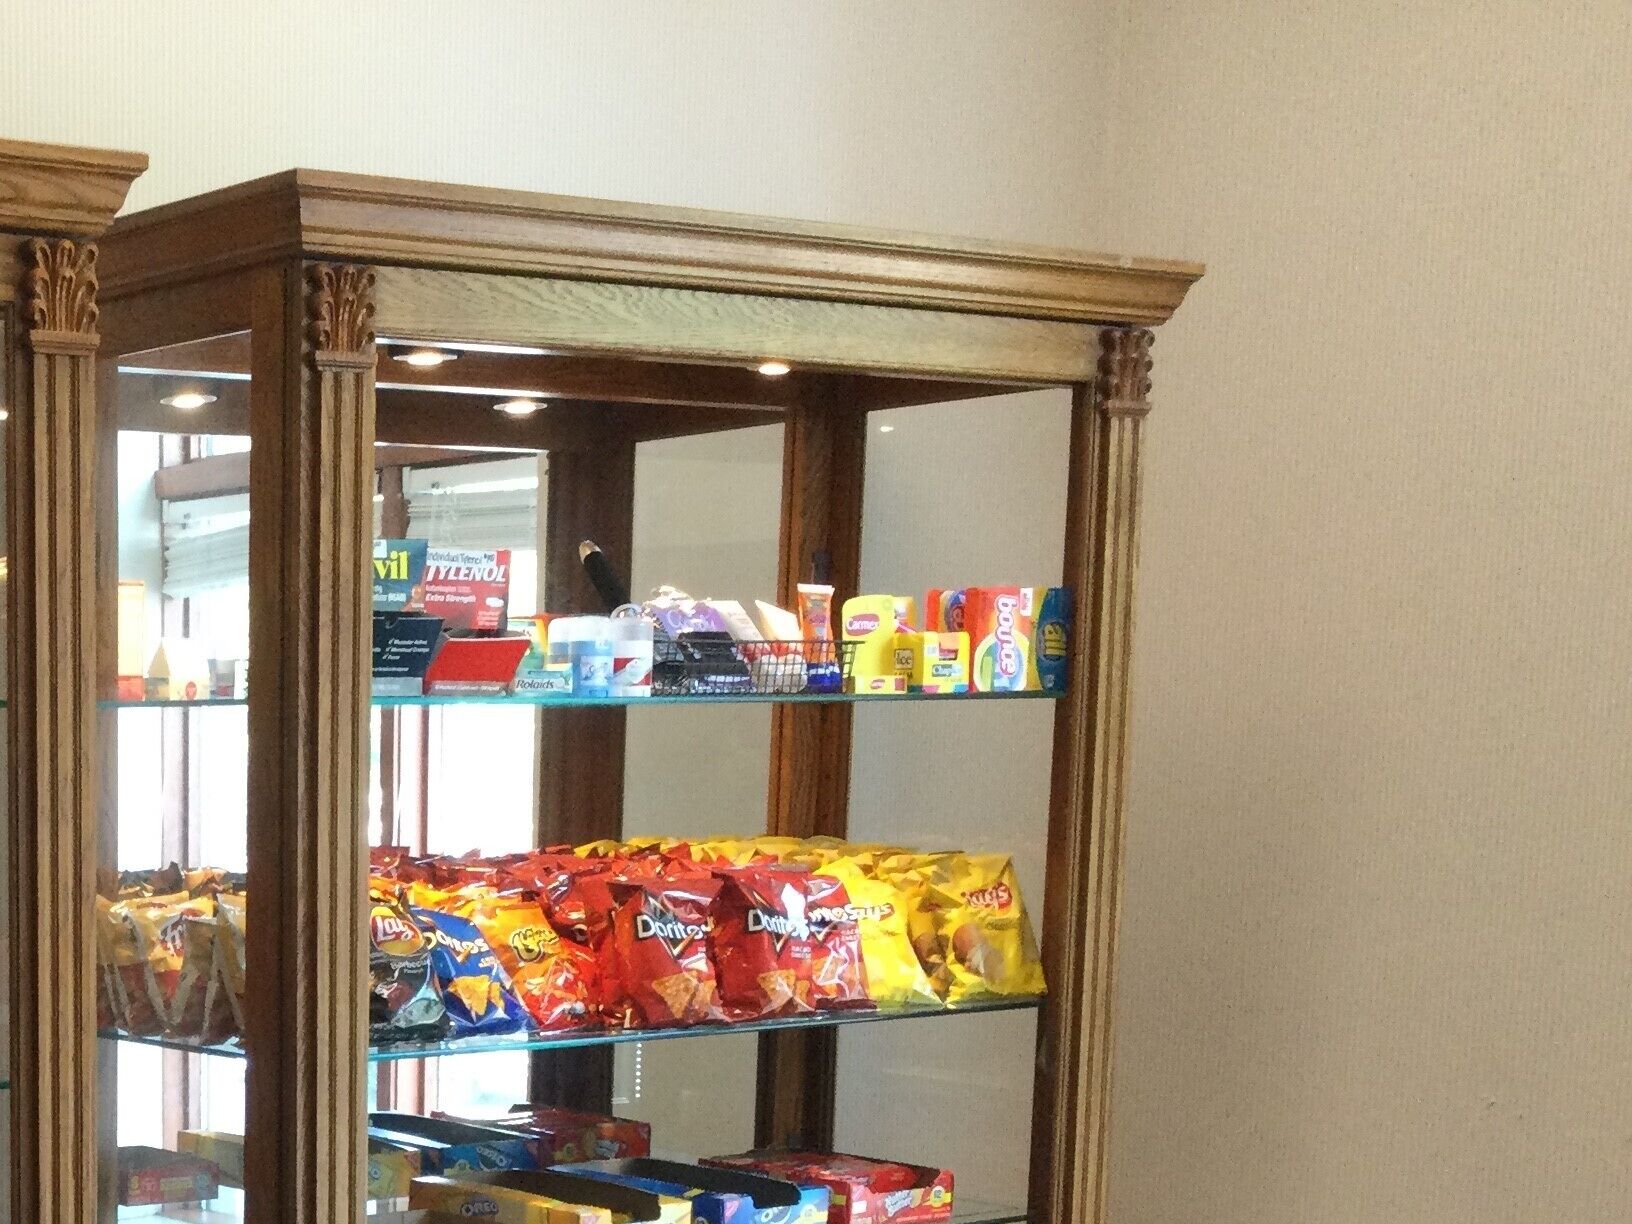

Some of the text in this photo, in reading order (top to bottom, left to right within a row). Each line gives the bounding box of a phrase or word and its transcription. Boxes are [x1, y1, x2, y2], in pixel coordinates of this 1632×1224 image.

[373, 550, 409, 580] vil
[425, 564, 506, 583] TYLENOL
[994, 594, 1017, 677] bounce
[516, 679, 555, 690] Rolaids
[460, 1201, 499, 1217] OREO
